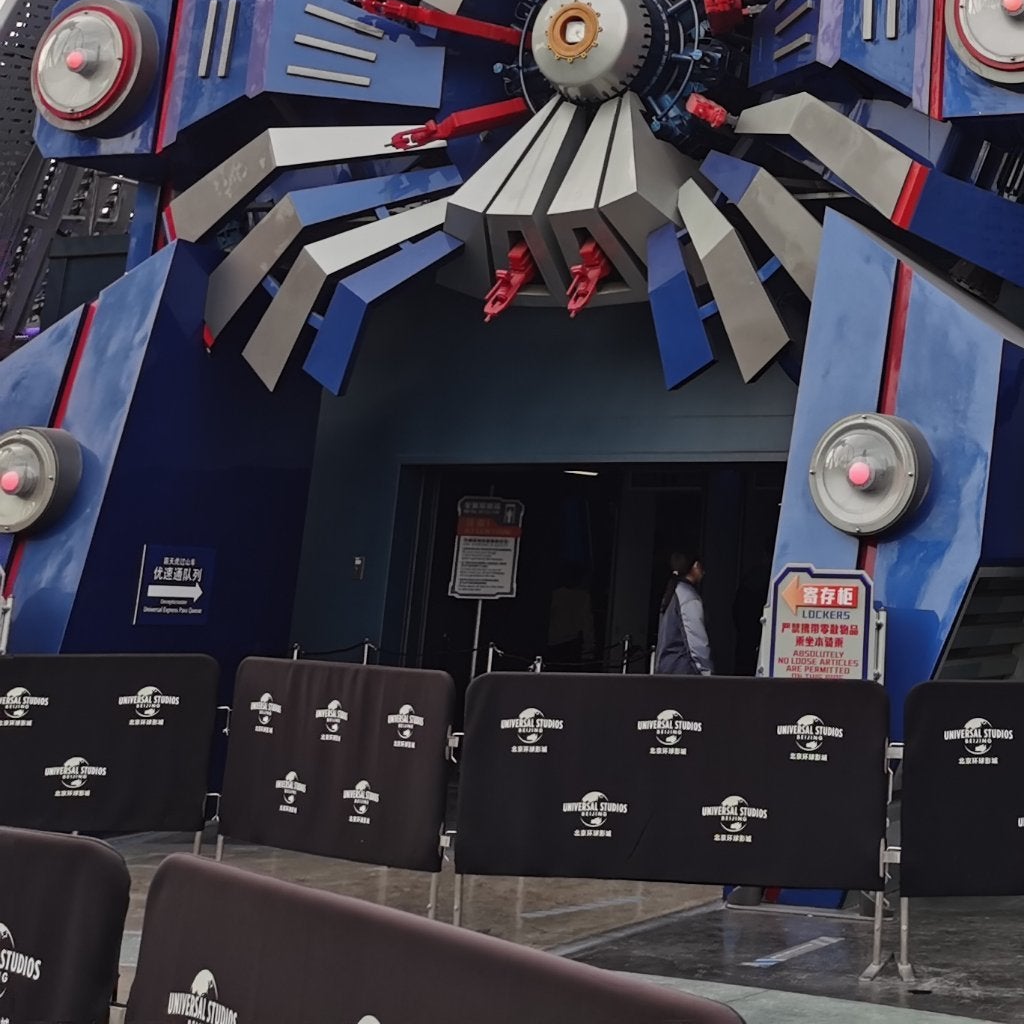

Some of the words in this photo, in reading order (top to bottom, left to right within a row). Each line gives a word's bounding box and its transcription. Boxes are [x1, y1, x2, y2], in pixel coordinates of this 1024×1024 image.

[154, 566, 202, 582] 优速通队列
[804, 587, 852, 605] 寄存柜
[802, 610, 850, 620] LOCKERS
[793, 650, 844, 658] ABSOLUTELY
[819, 658, 859, 667] ARTICLES
[804, 666, 850, 674] PERMITTED
[0, 696, 21, 704] VERSAL
[22, 696, 49, 706] STUDIOS
[119, 696, 152, 705] UNIVERSAL
[153, 696, 180, 706] STUDIOS
[501, 719, 535, 729] UNIVERSAL
[536, 719, 564, 730] STUDIOS
[637, 720, 673, 730] UNIVERSAL
[675, 720, 702, 732] STUDIOS
[777, 725, 813, 736] UNIVERSAL
[815, 725, 843, 738] STUDIOS
[944, 729, 982, 741] UNIVERSAL
[983, 729, 1014, 740] STUDIOS
[45, 767, 80, 776] UNIVERSAL
[81, 766, 107, 776] STUDIOS
[562, 802, 598, 812] UNIVERSAL
[599, 802, 628, 813] STUDIOS
[702, 806, 738, 816] UNIVERSAL
[739, 806, 768, 819] STUDIOS
[0, 948, 42, 980] STUDIOS
[168, 992, 206, 1021] UNIVERSAL
[206, 1000, 238, 1024] STUDIOS
